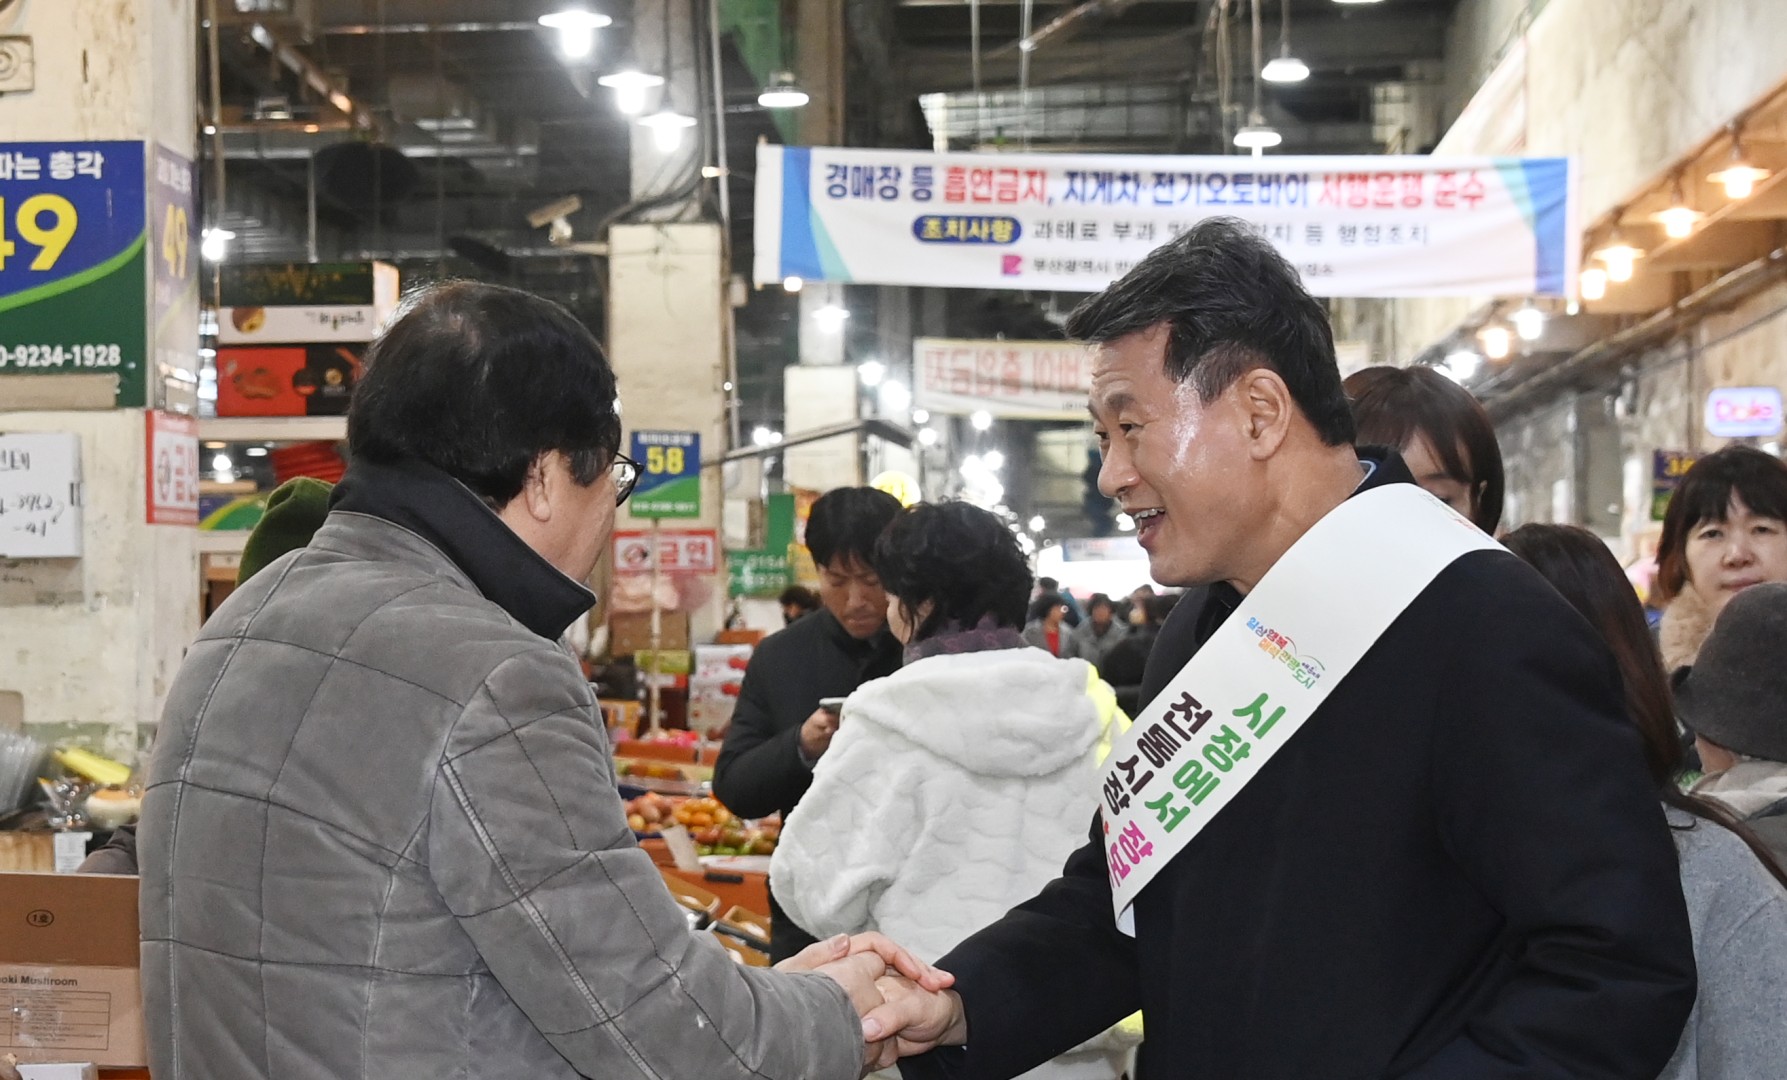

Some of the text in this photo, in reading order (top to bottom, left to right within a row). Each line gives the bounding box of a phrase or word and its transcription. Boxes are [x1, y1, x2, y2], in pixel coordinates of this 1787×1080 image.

[49, 150, 104, 180] 총각
[826, 163, 902, 201] 경매장
[911, 165, 933, 202] 등
[944, 166, 1054, 207] 흡연금지,
[1318, 172, 1423, 208] 서행운행
[1434, 169, 1486, 209] 준수
[0, 192, 79, 272] 9
[922, 217, 1014, 243] 조치사항
[1033, 220, 1097, 241] 과태료
[1113, 222, 1153, 241] 부과
[1306, 225, 1322, 243] 등
[646, 446, 685, 474] 58
[1102, 690, 1213, 816] 전통시장
[1144, 692, 1287, 834] 시장에서
[0, 975, 78, 986] oki Mushroom
